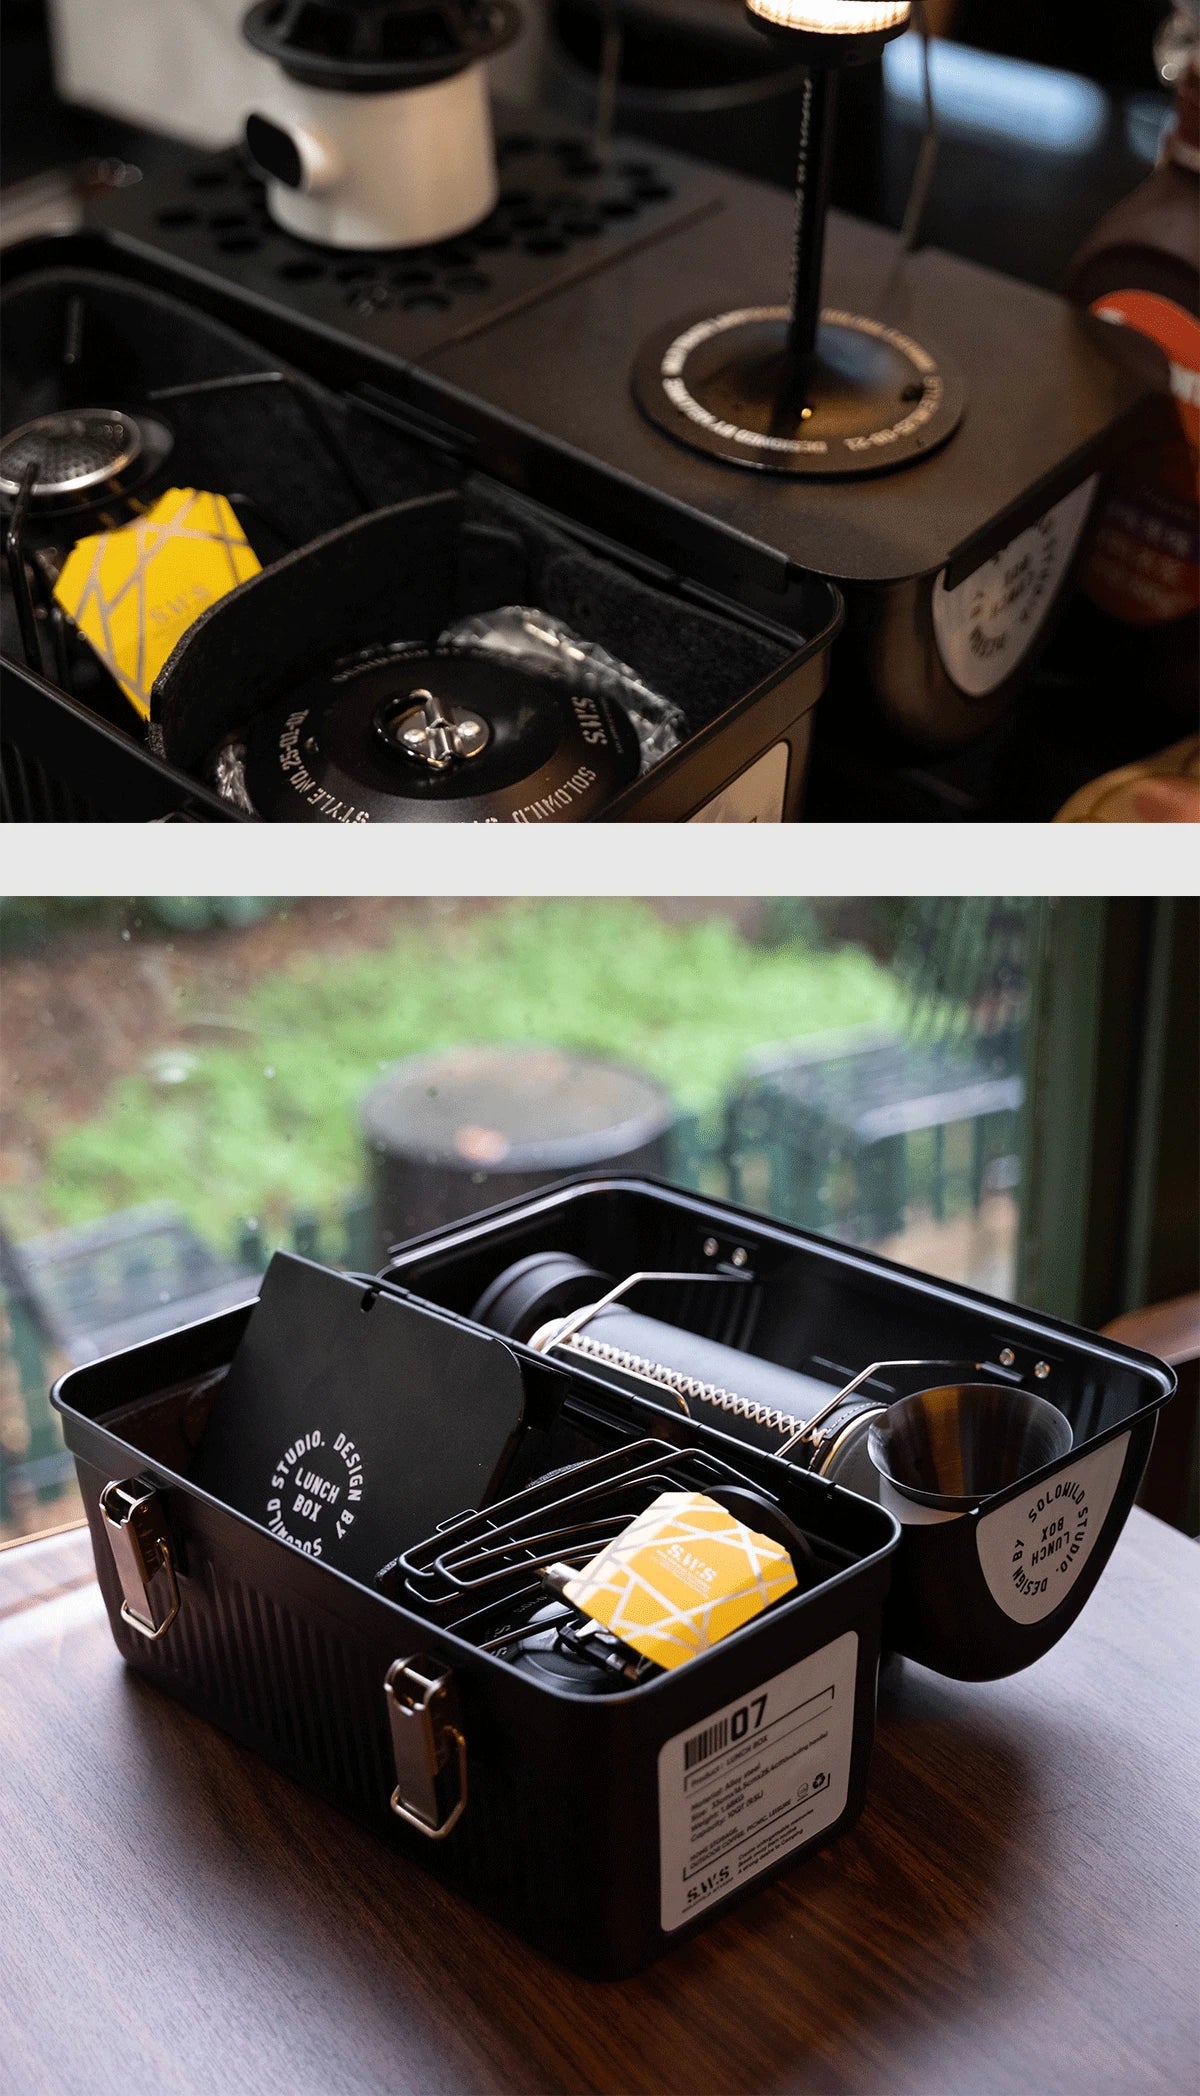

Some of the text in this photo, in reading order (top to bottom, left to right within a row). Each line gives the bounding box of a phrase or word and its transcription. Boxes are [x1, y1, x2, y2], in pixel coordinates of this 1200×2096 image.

[272, 1430, 325, 1490] STUDIO.
[333, 1432, 363, 1501] DESIGN
[295, 1467, 340, 1504] LUNCH
[292, 1493, 322, 1522] BOX
[335, 1509, 354, 1539] BY
[1012, 1481, 1089, 1596] SOLOWILD STUDIO. DESIGN BY
[1041, 1516, 1065, 1542] BOX
[1031, 1531, 1070, 1566] LUNCH
[731, 1693, 768, 1741] 07
